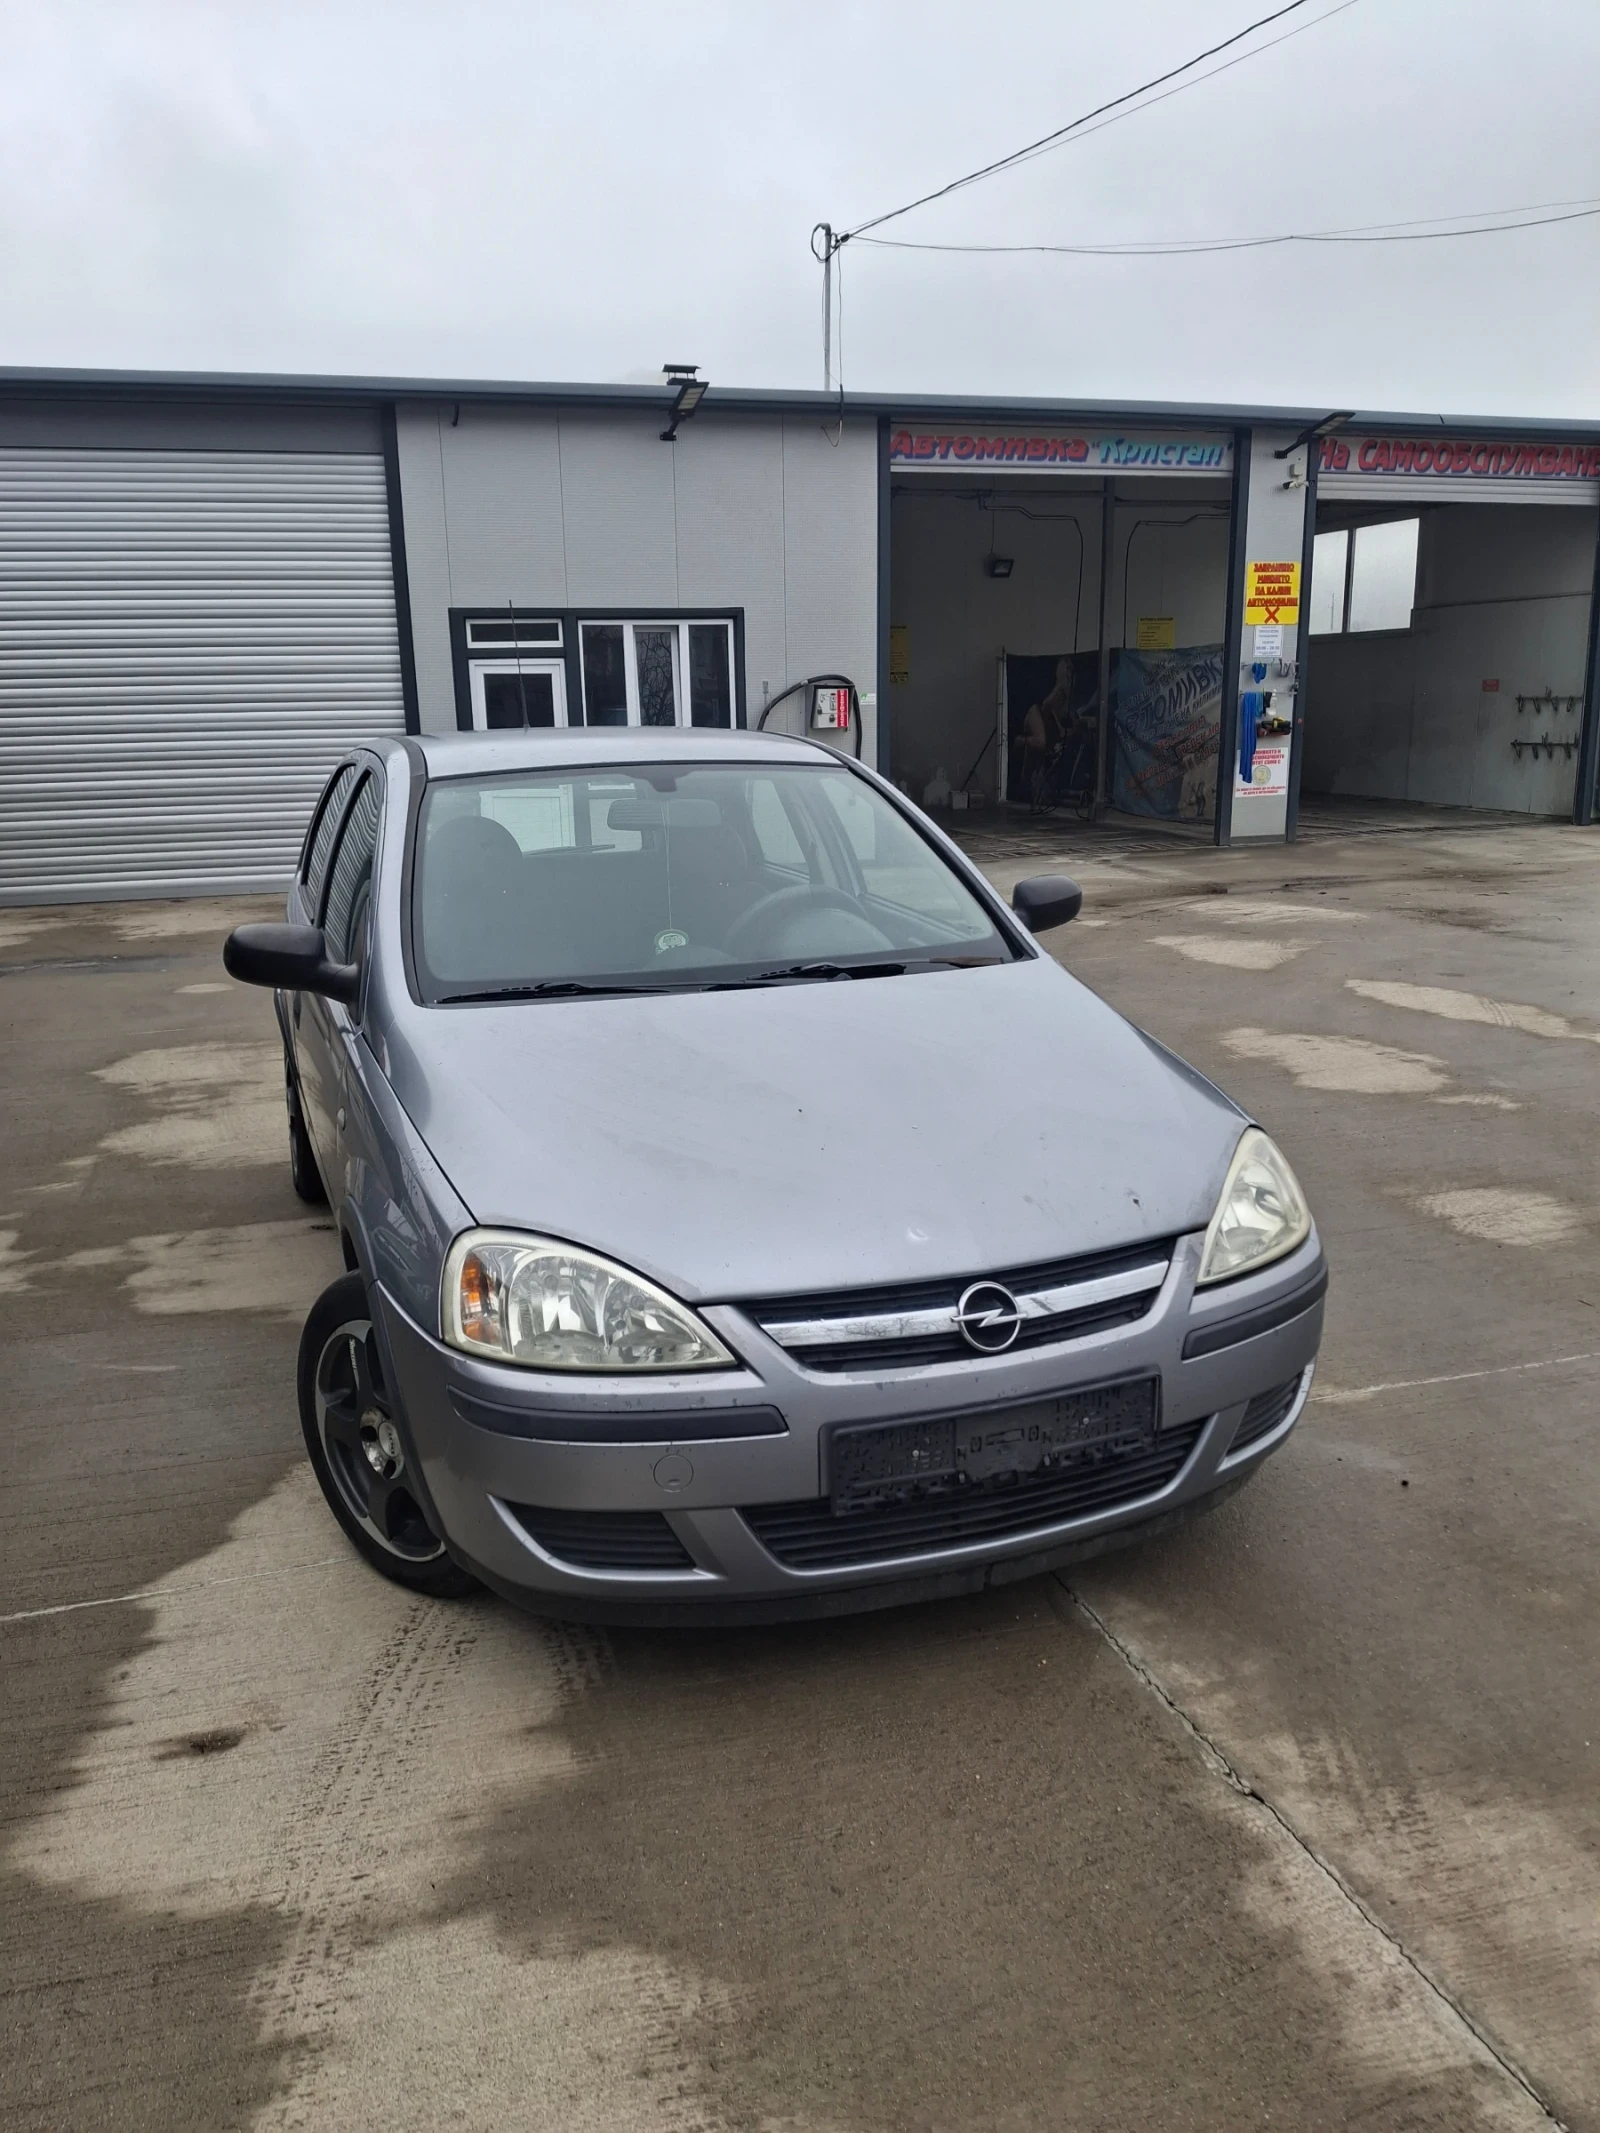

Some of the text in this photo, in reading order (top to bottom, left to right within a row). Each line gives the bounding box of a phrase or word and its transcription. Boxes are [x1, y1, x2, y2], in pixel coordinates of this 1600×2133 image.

[890, 430, 1090, 463] Автомивка
[1319, 437, 1350, 470] На
[1115, 652, 1223, 741] ВТОМИВК
